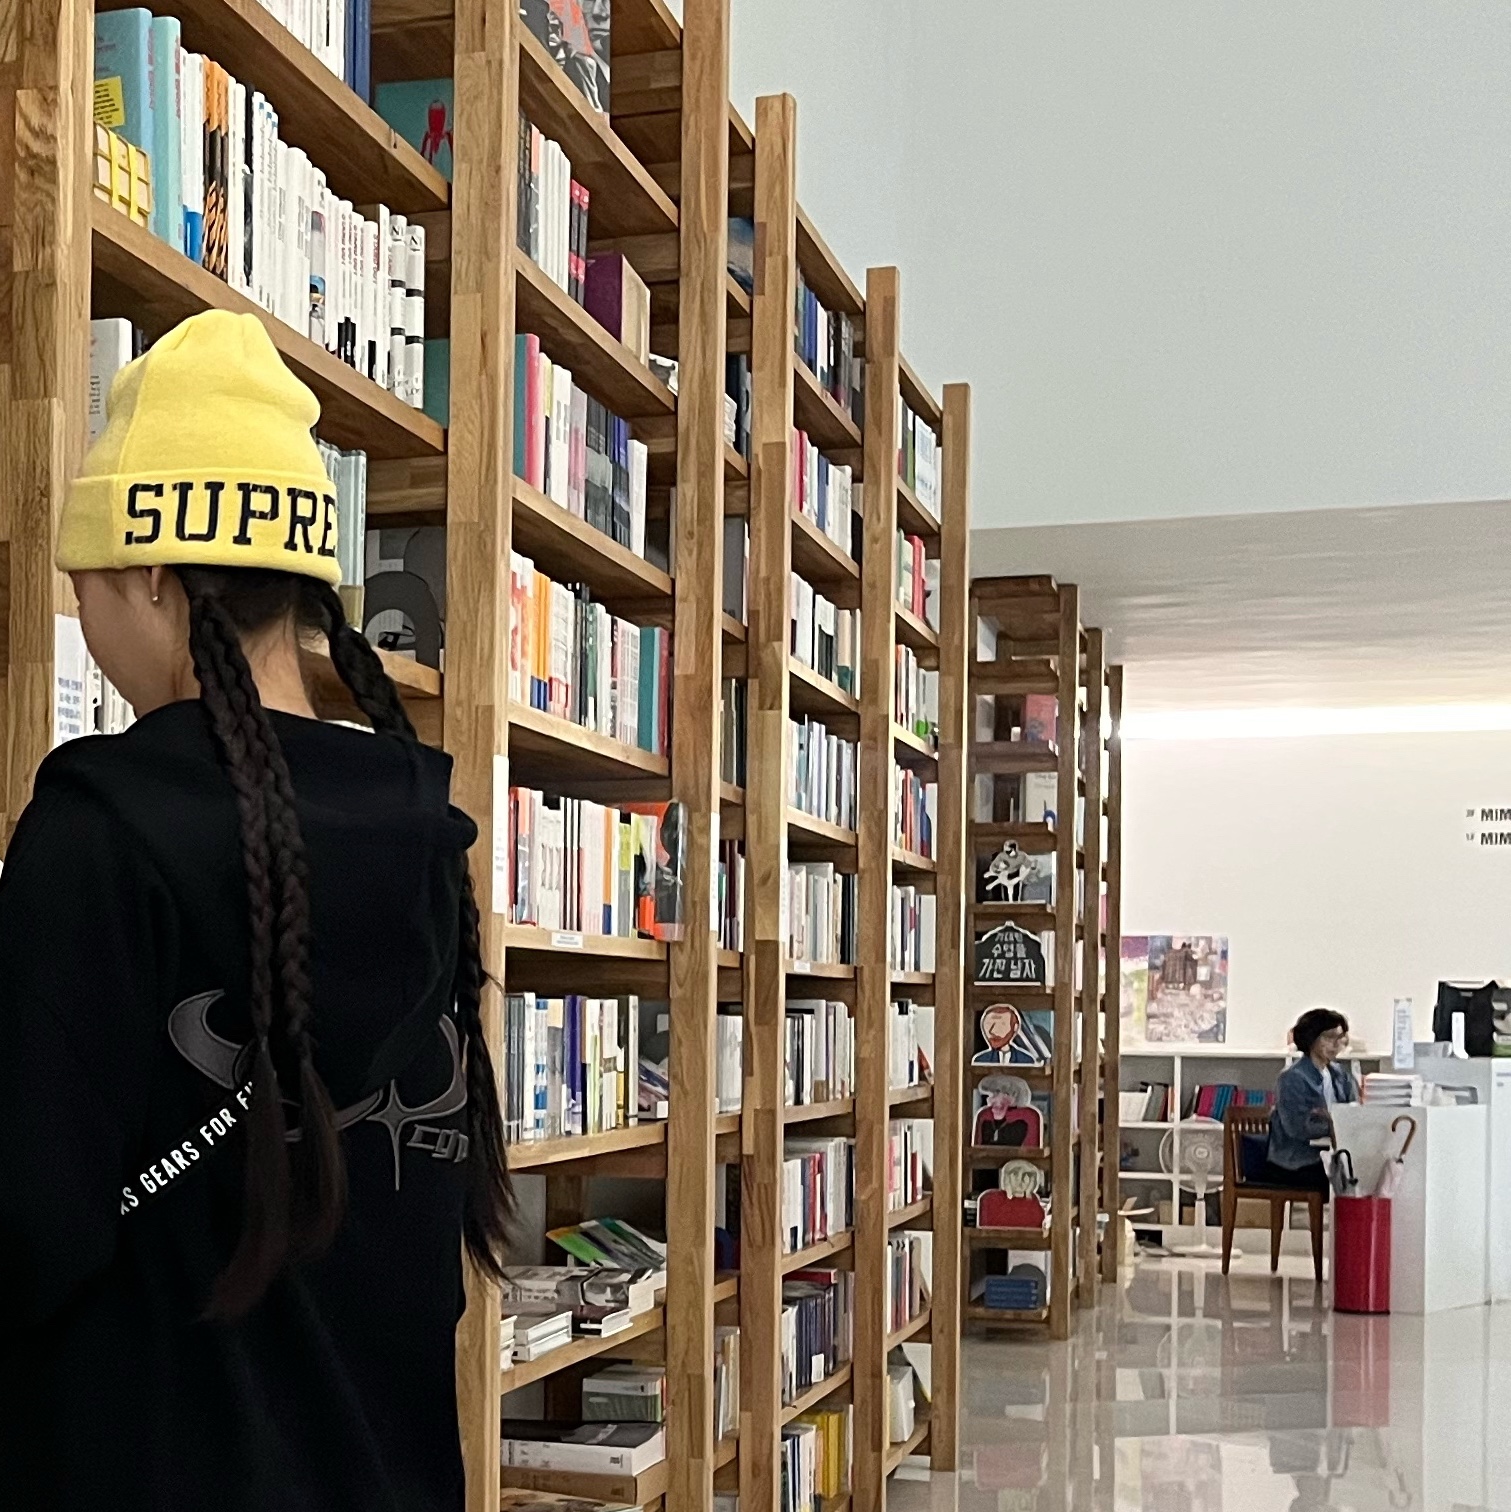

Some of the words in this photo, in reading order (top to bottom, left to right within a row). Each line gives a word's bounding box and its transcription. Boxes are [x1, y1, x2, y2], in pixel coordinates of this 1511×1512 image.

[124, 481, 336, 558] SUPRE
[139, 1141, 200, 1194] GEARS
[199, 1108, 237, 1146] FOR
